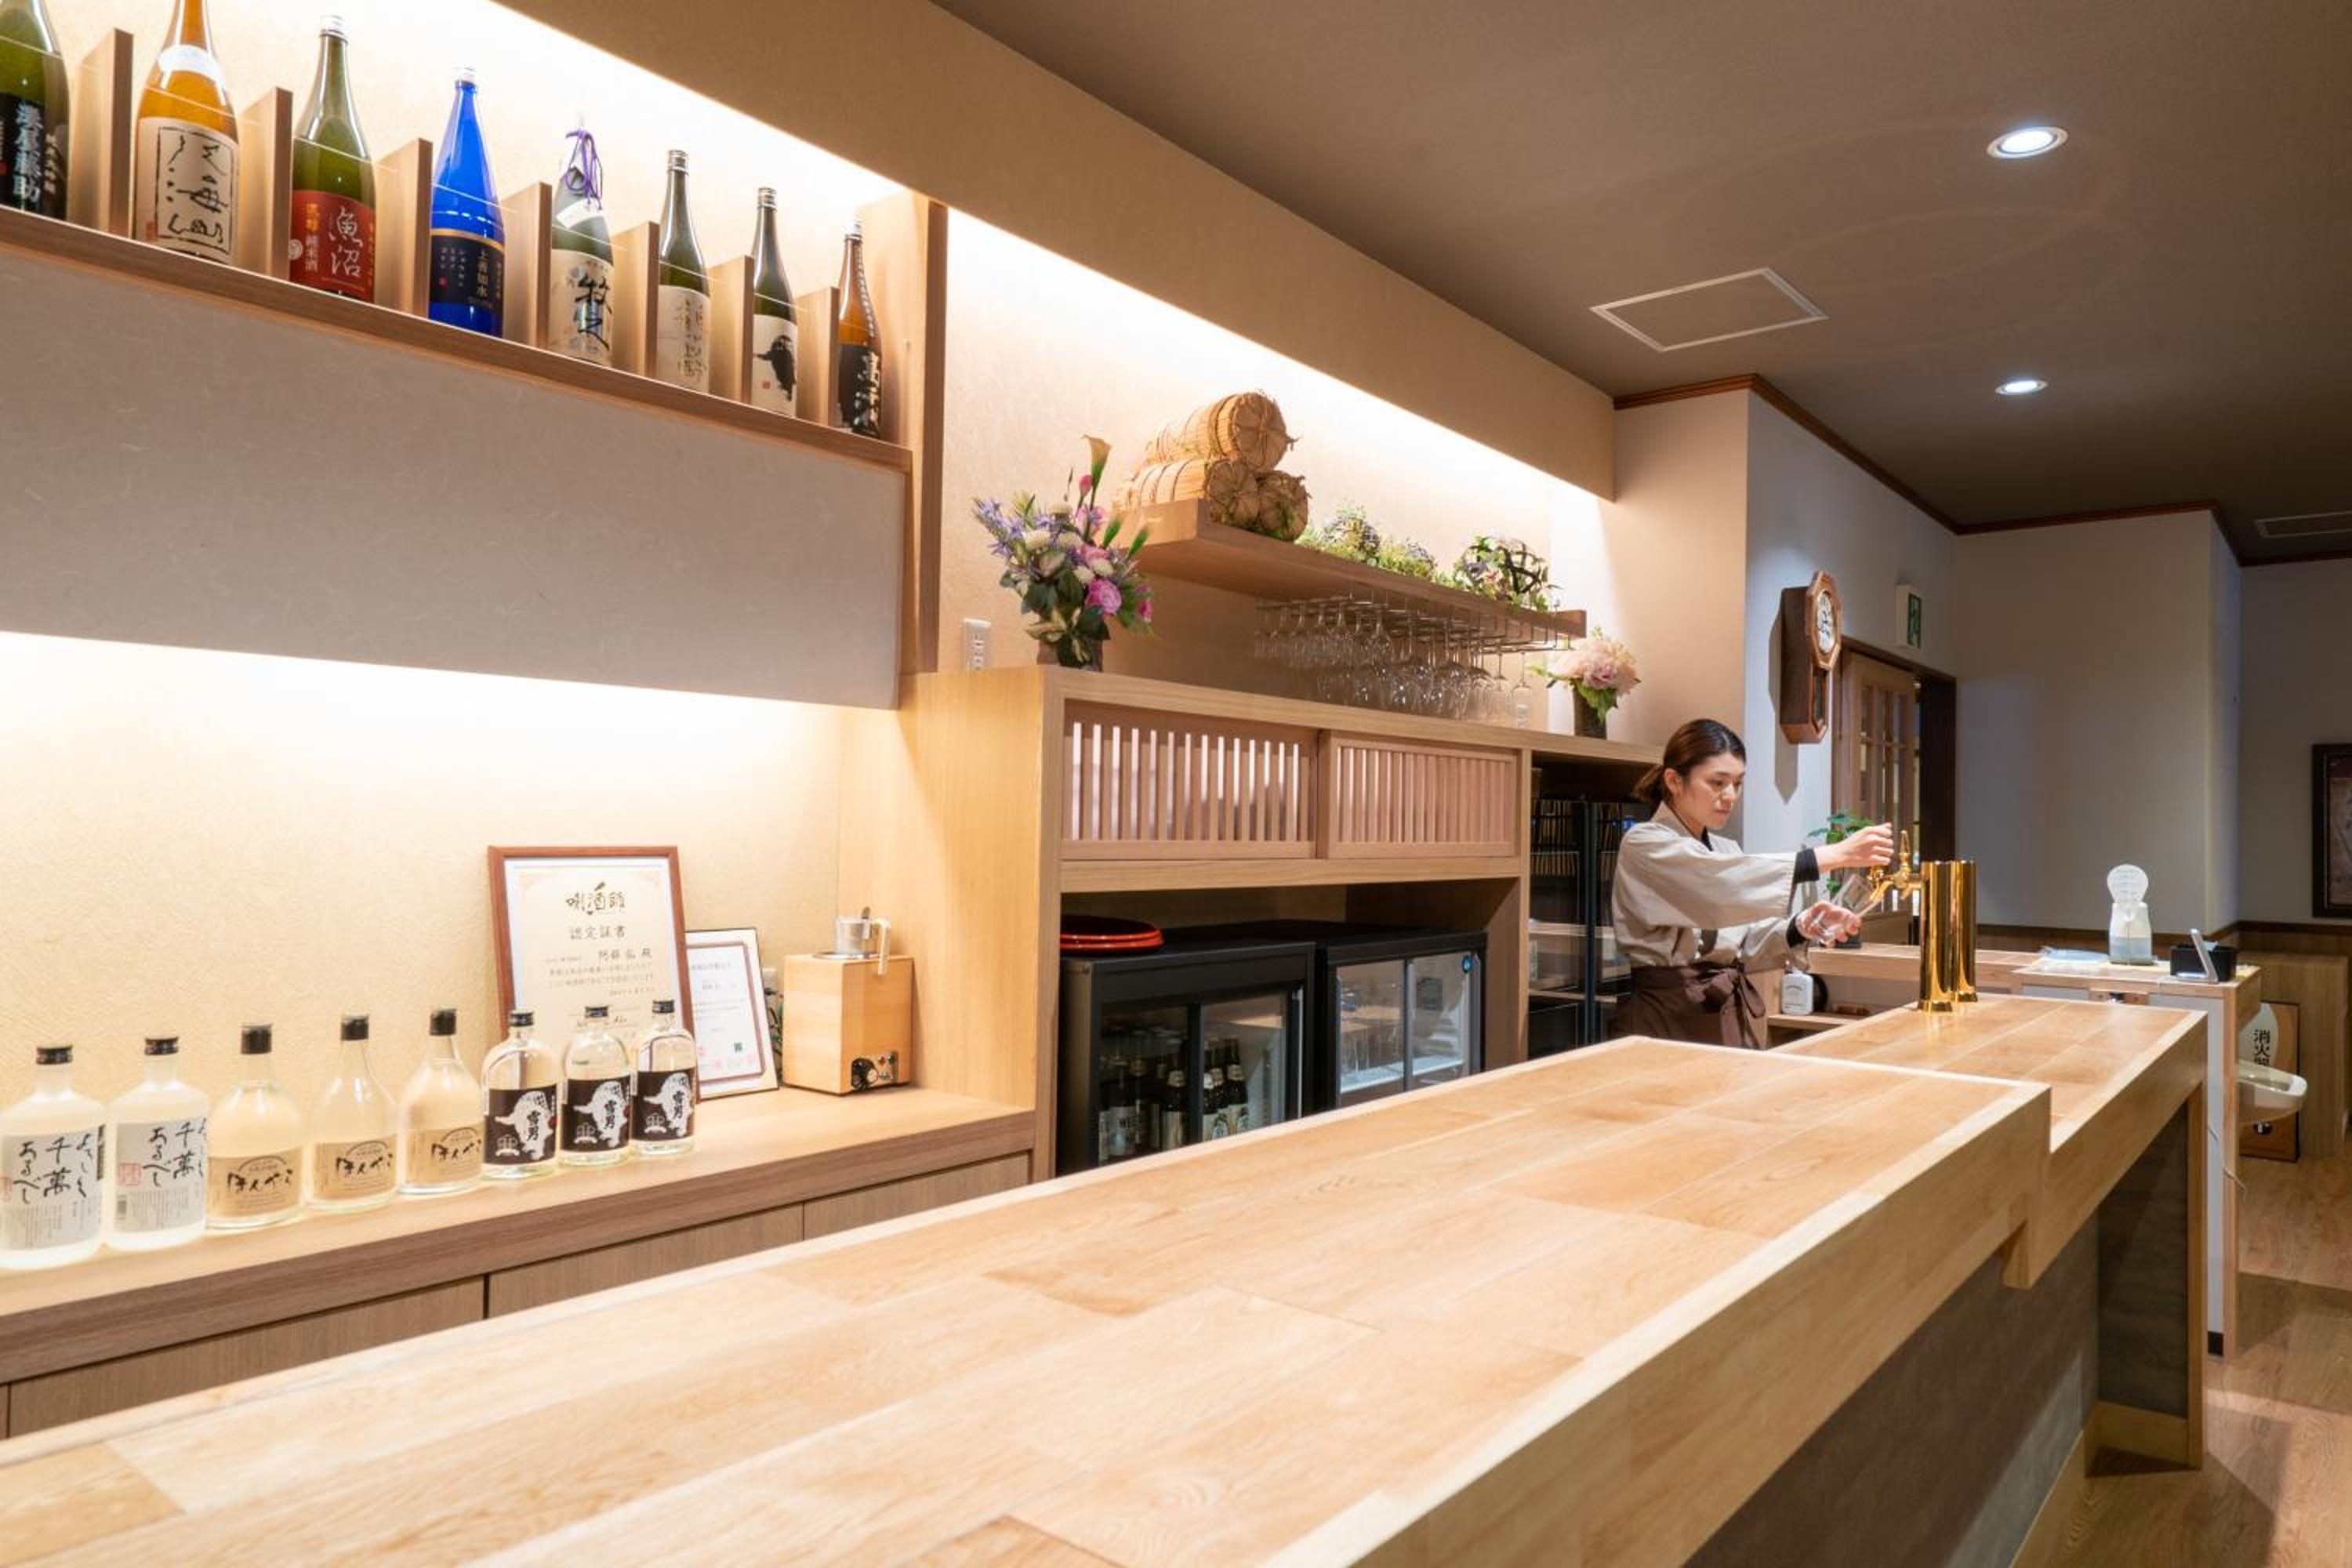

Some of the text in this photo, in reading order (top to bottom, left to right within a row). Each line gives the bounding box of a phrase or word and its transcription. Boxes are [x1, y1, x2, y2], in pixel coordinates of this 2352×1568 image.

[328, 205, 364, 278] 魚沼
[476, 249, 490, 297] 上善如水
